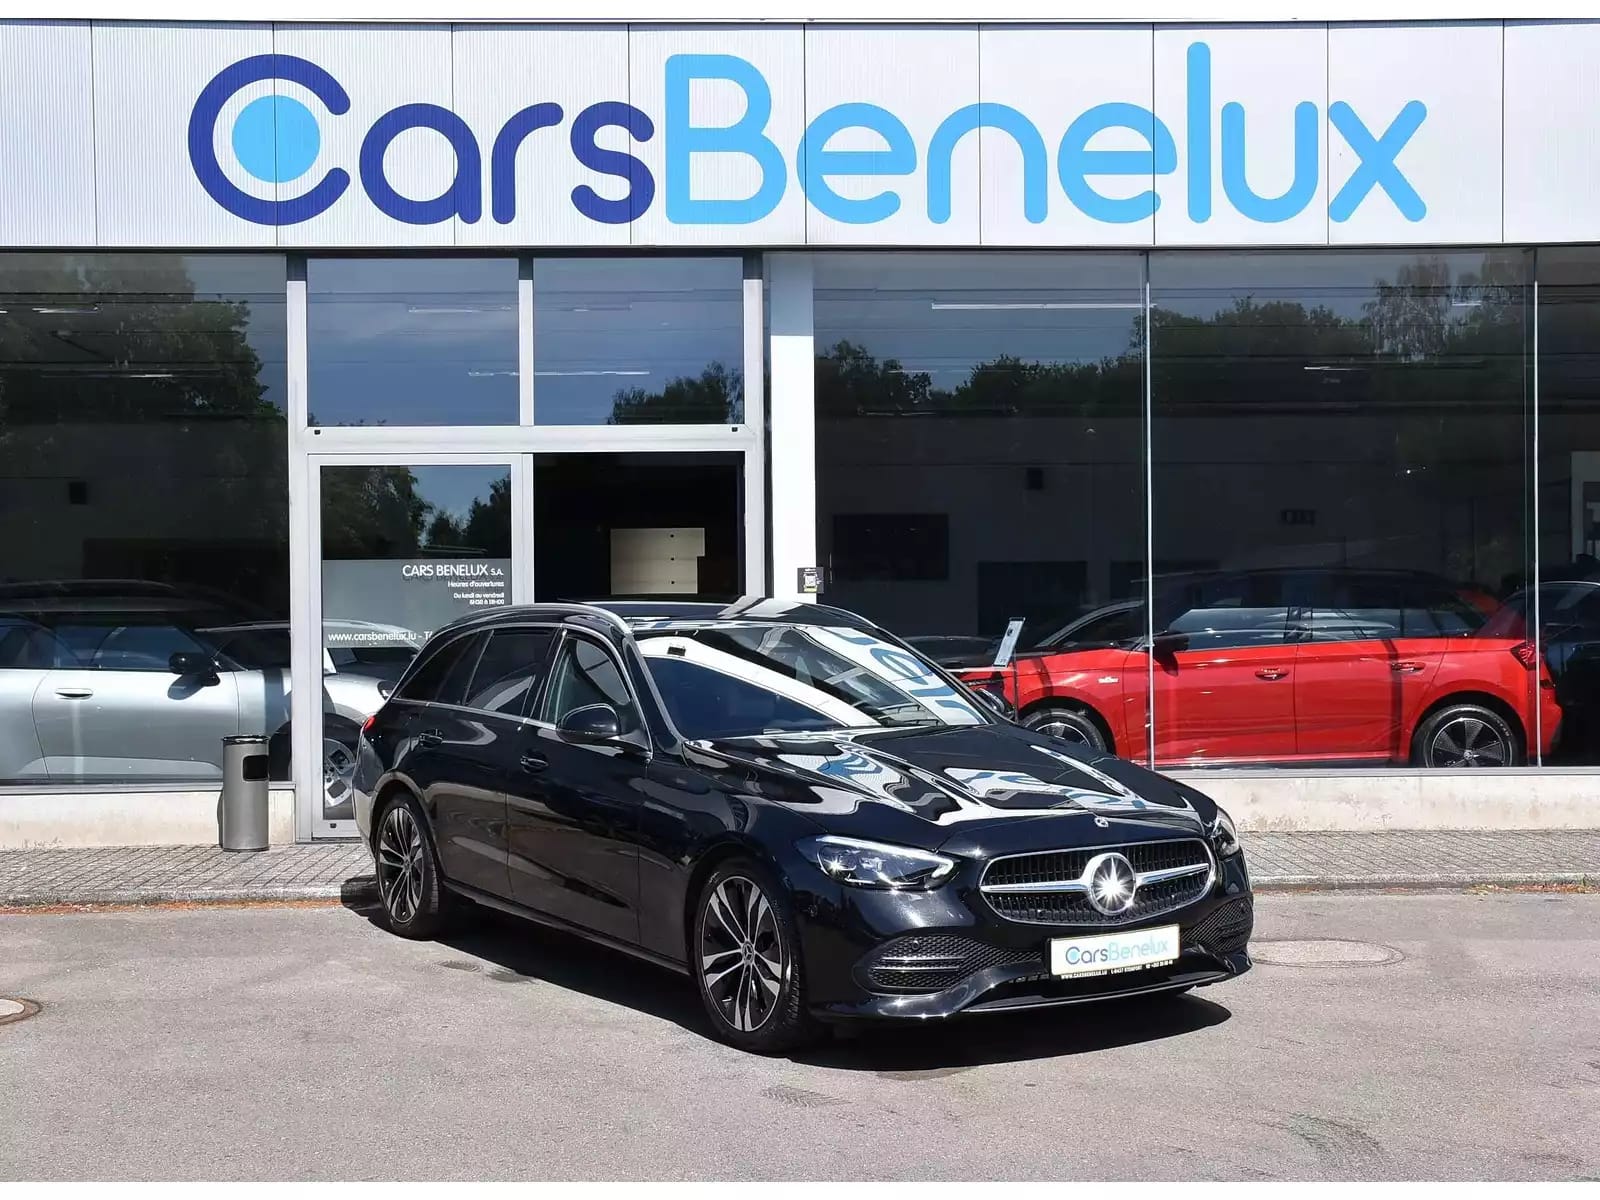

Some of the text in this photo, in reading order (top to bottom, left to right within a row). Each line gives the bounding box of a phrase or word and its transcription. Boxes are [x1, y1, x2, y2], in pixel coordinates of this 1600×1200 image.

[188, 42, 1427, 225] CarsBenelux
[402, 564, 434, 577] CARS
[436, 563, 489, 576] BENELUX
[469, 580, 505, 589] d'ouvertures
[327, 632, 417, 641] www.carsbenelux.lu
[1065, 935, 1168, 965] CarsBenelux
